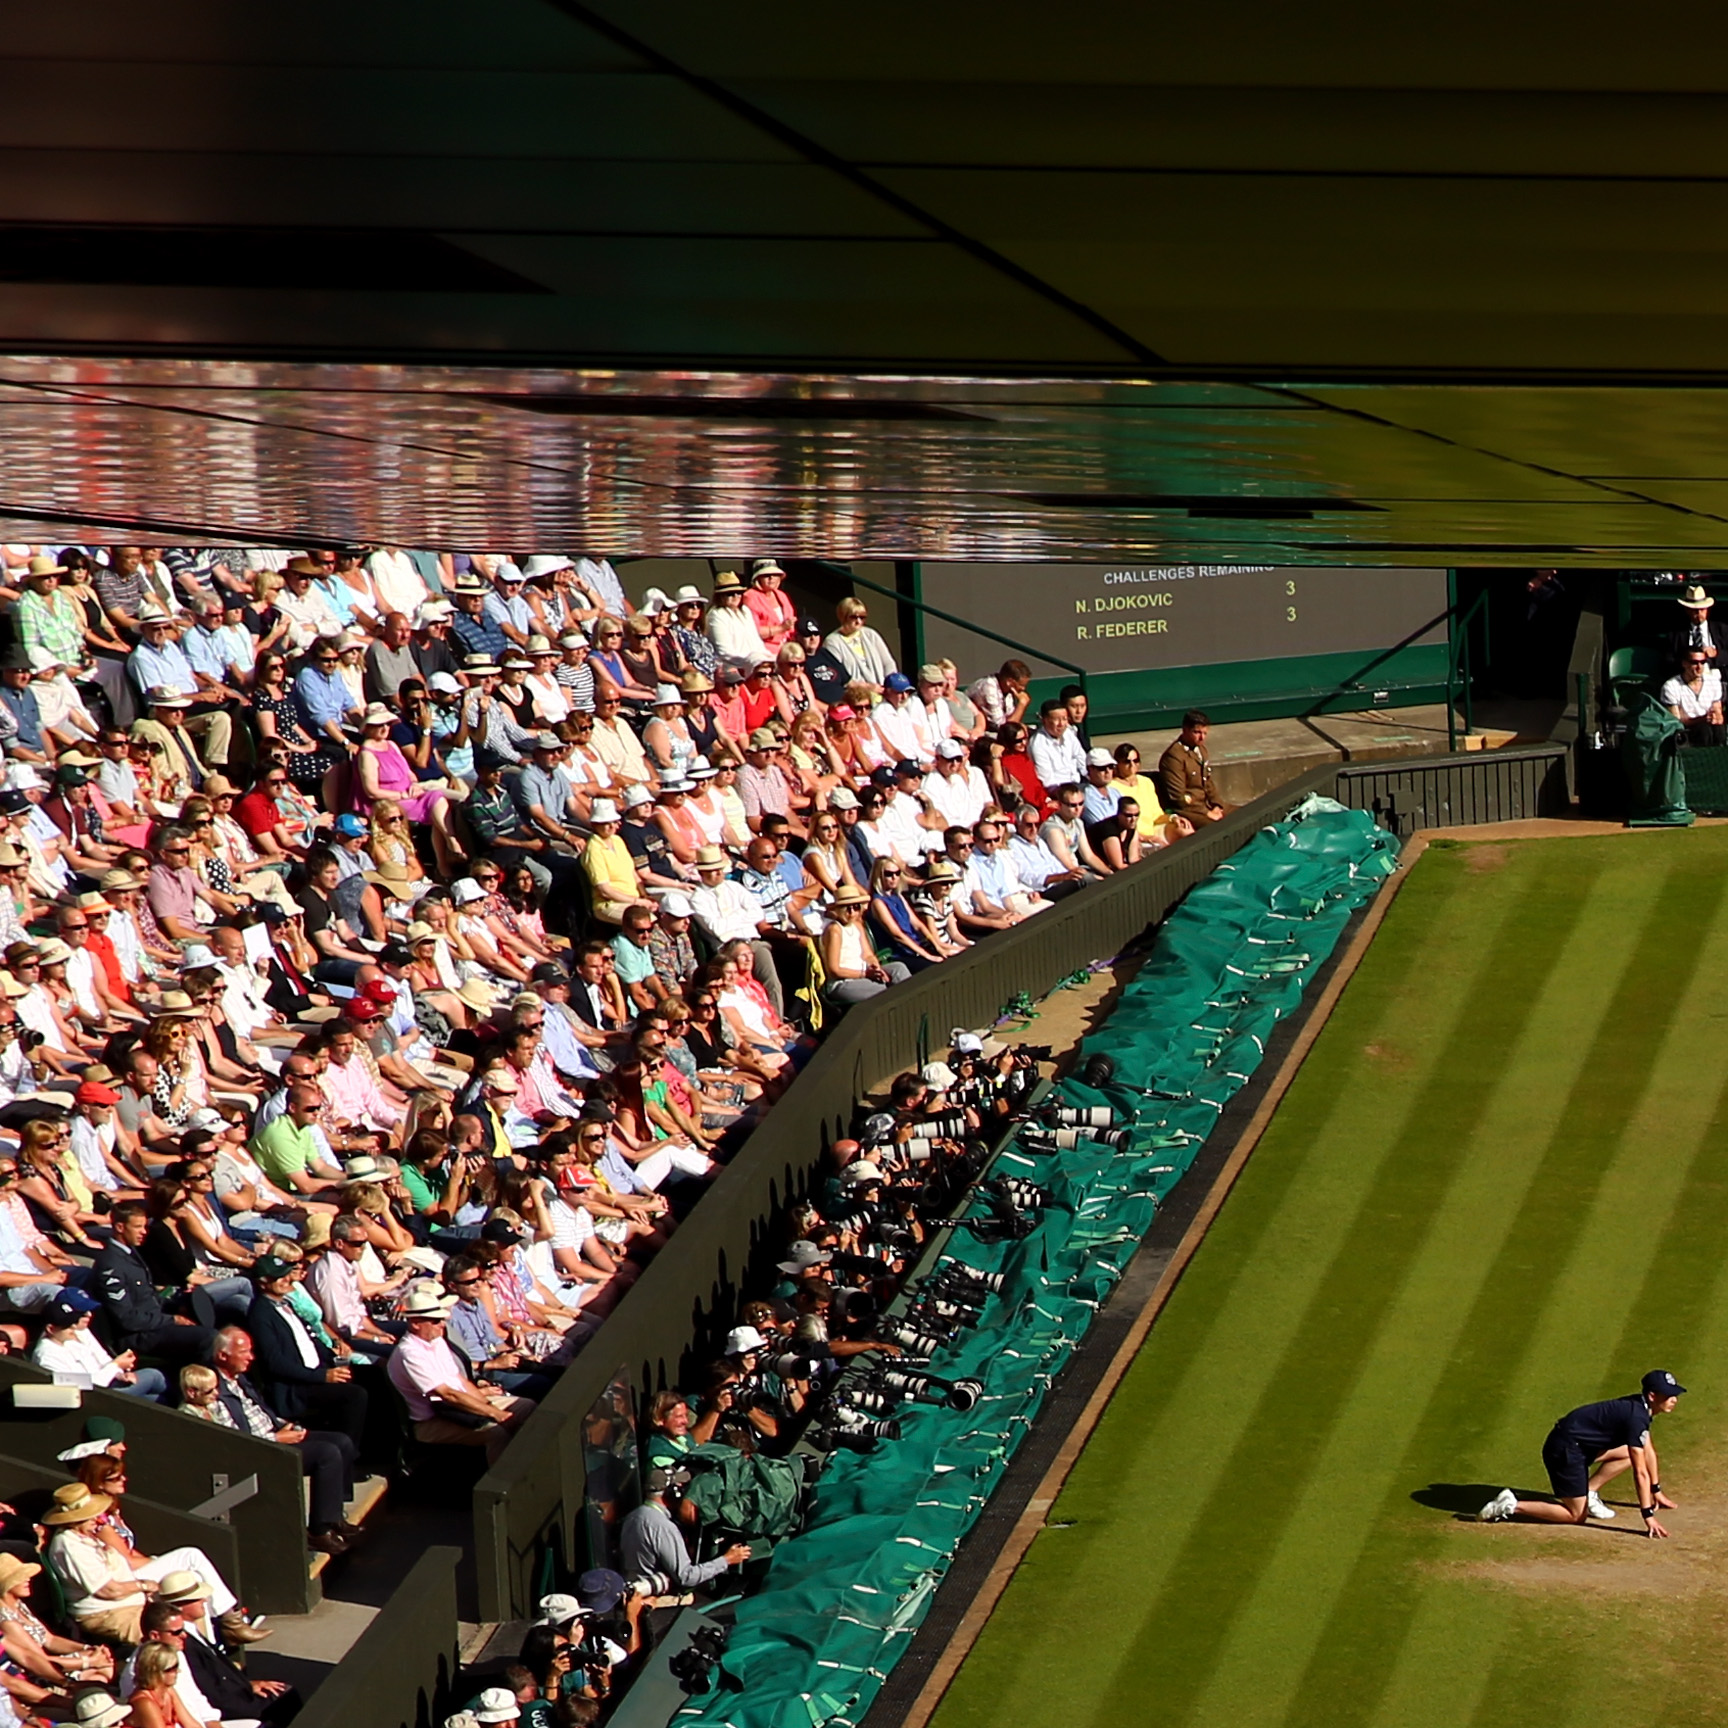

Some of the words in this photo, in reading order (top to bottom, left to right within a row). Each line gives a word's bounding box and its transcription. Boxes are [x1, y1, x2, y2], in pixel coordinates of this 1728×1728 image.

[1103, 566, 1195, 585] CHALLENGES
[1286, 580, 1296, 596] 3
[1075, 600, 1091, 613] N.
[1094, 593, 1173, 613] DJOKOVIC
[1286, 606, 1297, 622] 3
[1076, 626, 1093, 640] R.
[1095, 619, 1168, 638] FEDERER
